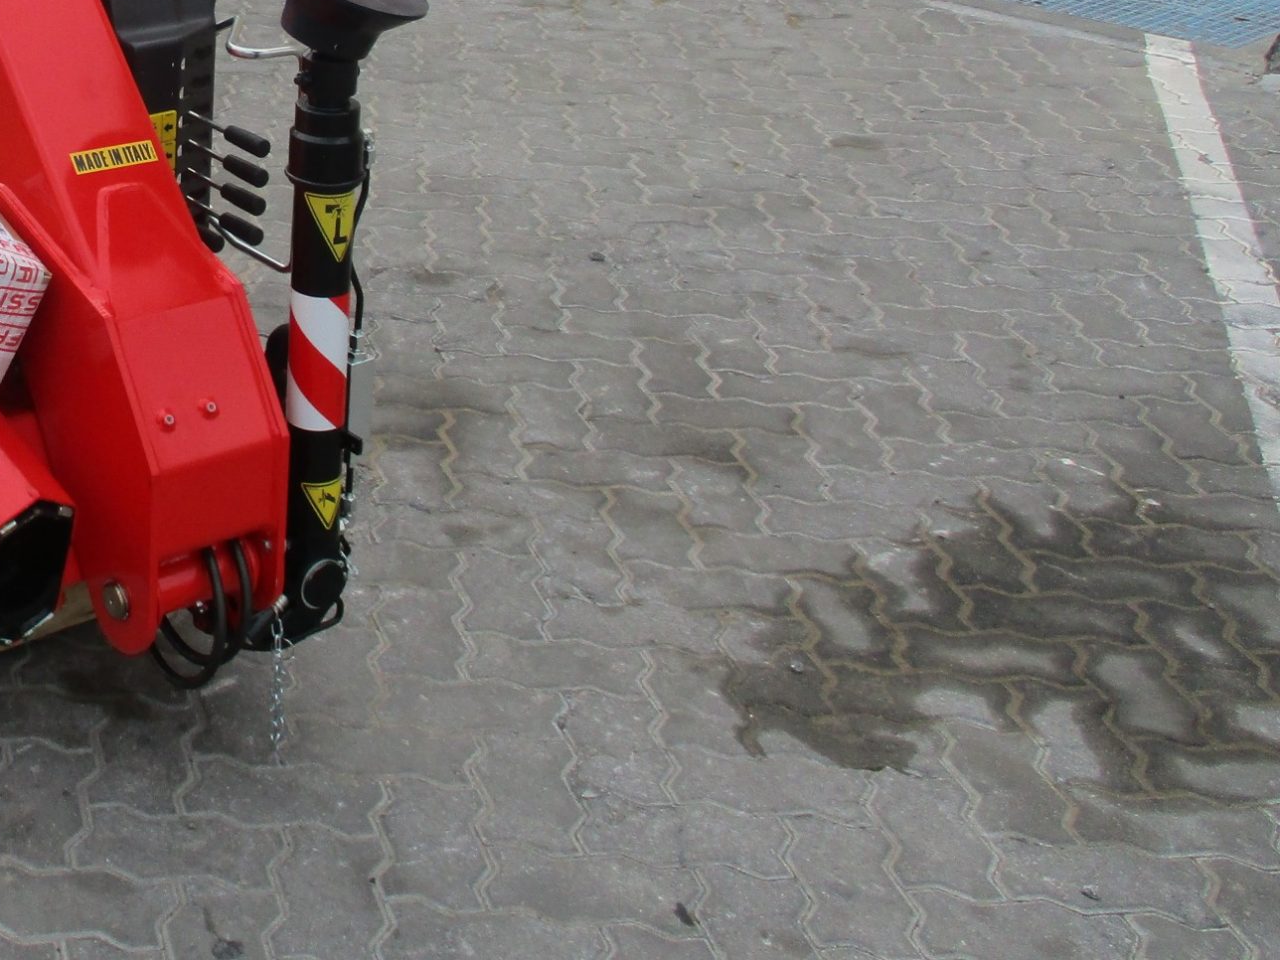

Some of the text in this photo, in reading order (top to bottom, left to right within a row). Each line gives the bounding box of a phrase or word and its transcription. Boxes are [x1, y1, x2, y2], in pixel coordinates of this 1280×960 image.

[73, 143, 152, 172] MADE IN ITALY
